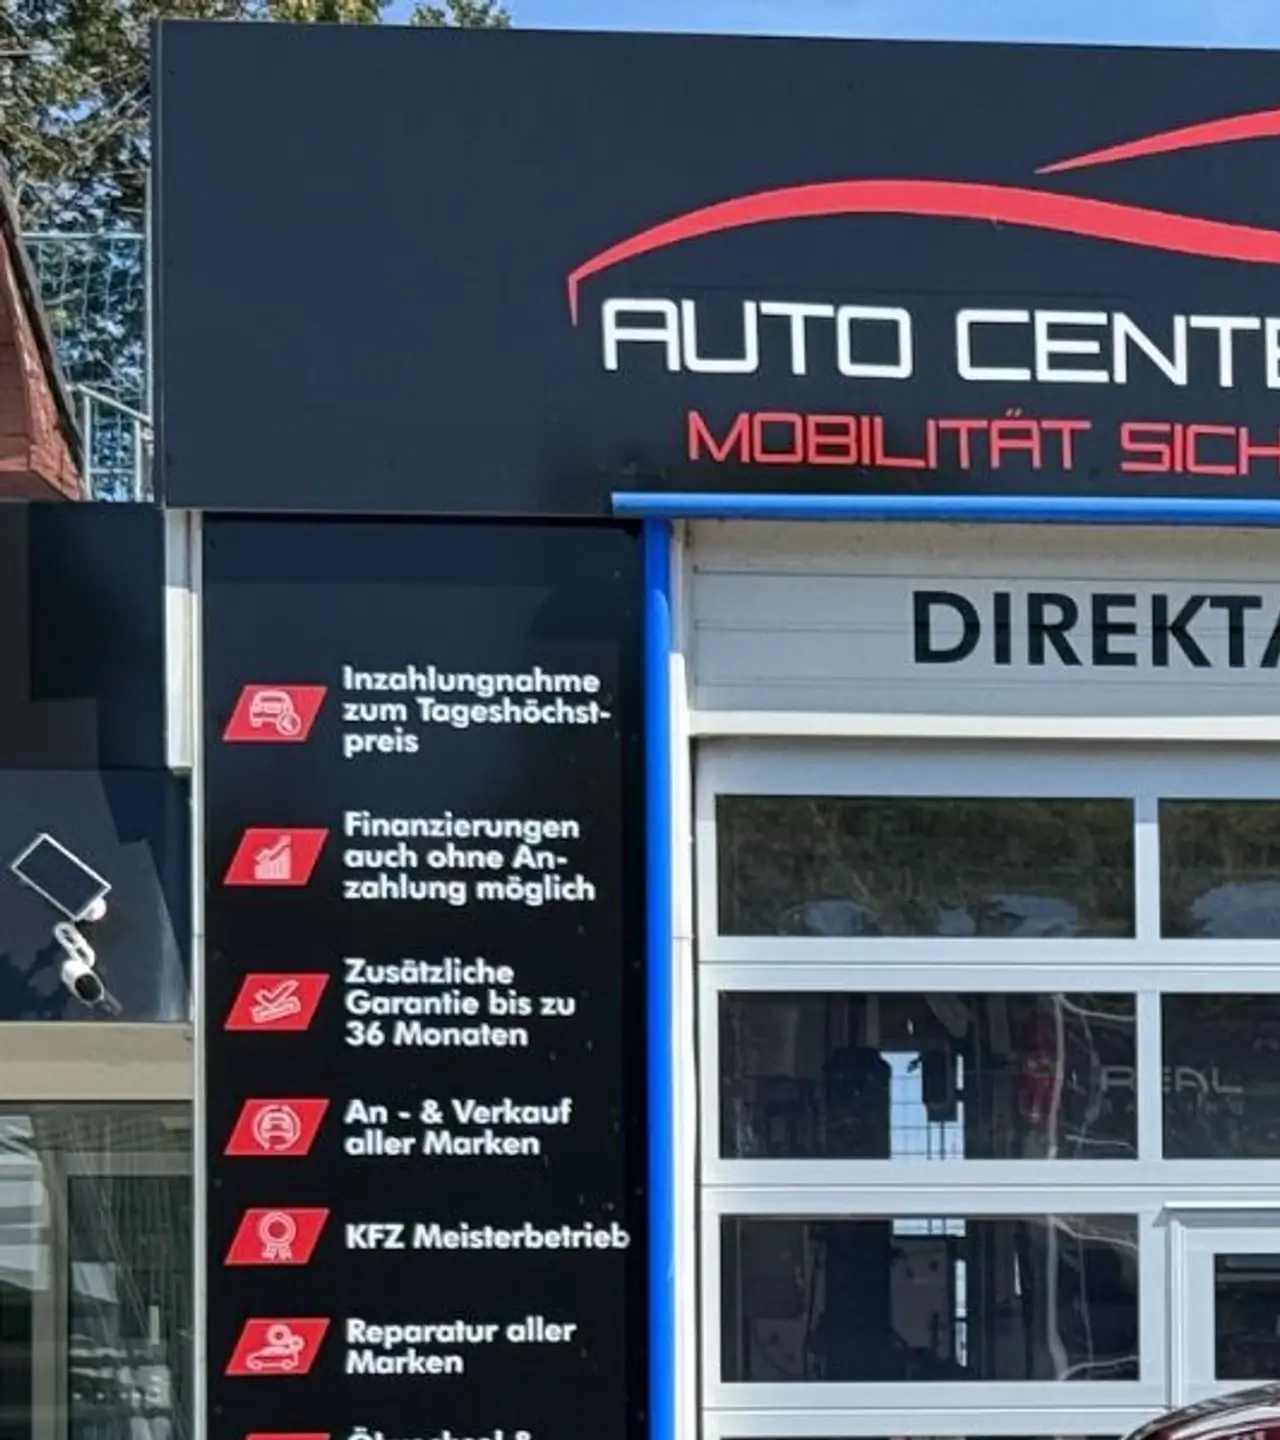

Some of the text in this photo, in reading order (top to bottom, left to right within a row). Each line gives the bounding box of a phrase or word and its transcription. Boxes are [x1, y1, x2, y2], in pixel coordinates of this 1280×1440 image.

[602, 298, 913, 379] AUTO
[686, 408, 1091, 471] MOBILITÄT
[343, 665, 600, 698] Inzahlungnahme
[343, 696, 611, 729] zum Tageshöchst-
[344, 728, 419, 758] preis
[345, 810, 580, 845] Finanzierungen
[344, 842, 568, 869] auch ohne An-
[344, 873, 596, 906] zahlung möglich
[344, 957, 515, 985] Zusätzliche
[345, 989, 576, 1016] Garantie bis zu
[345, 1020, 528, 1047] 36 Monaten
[344, 1099, 388, 1124] An
[420, 1099, 443, 1124] &
[451, 1097, 572, 1124] Verkauf
[345, 1128, 540, 1156] aller Marken
[346, 1222, 630, 1249] KFZ Meisterbetrieb
[346, 1315, 577, 1350] Reparatur aller
[345, 1347, 464, 1374] Marken
